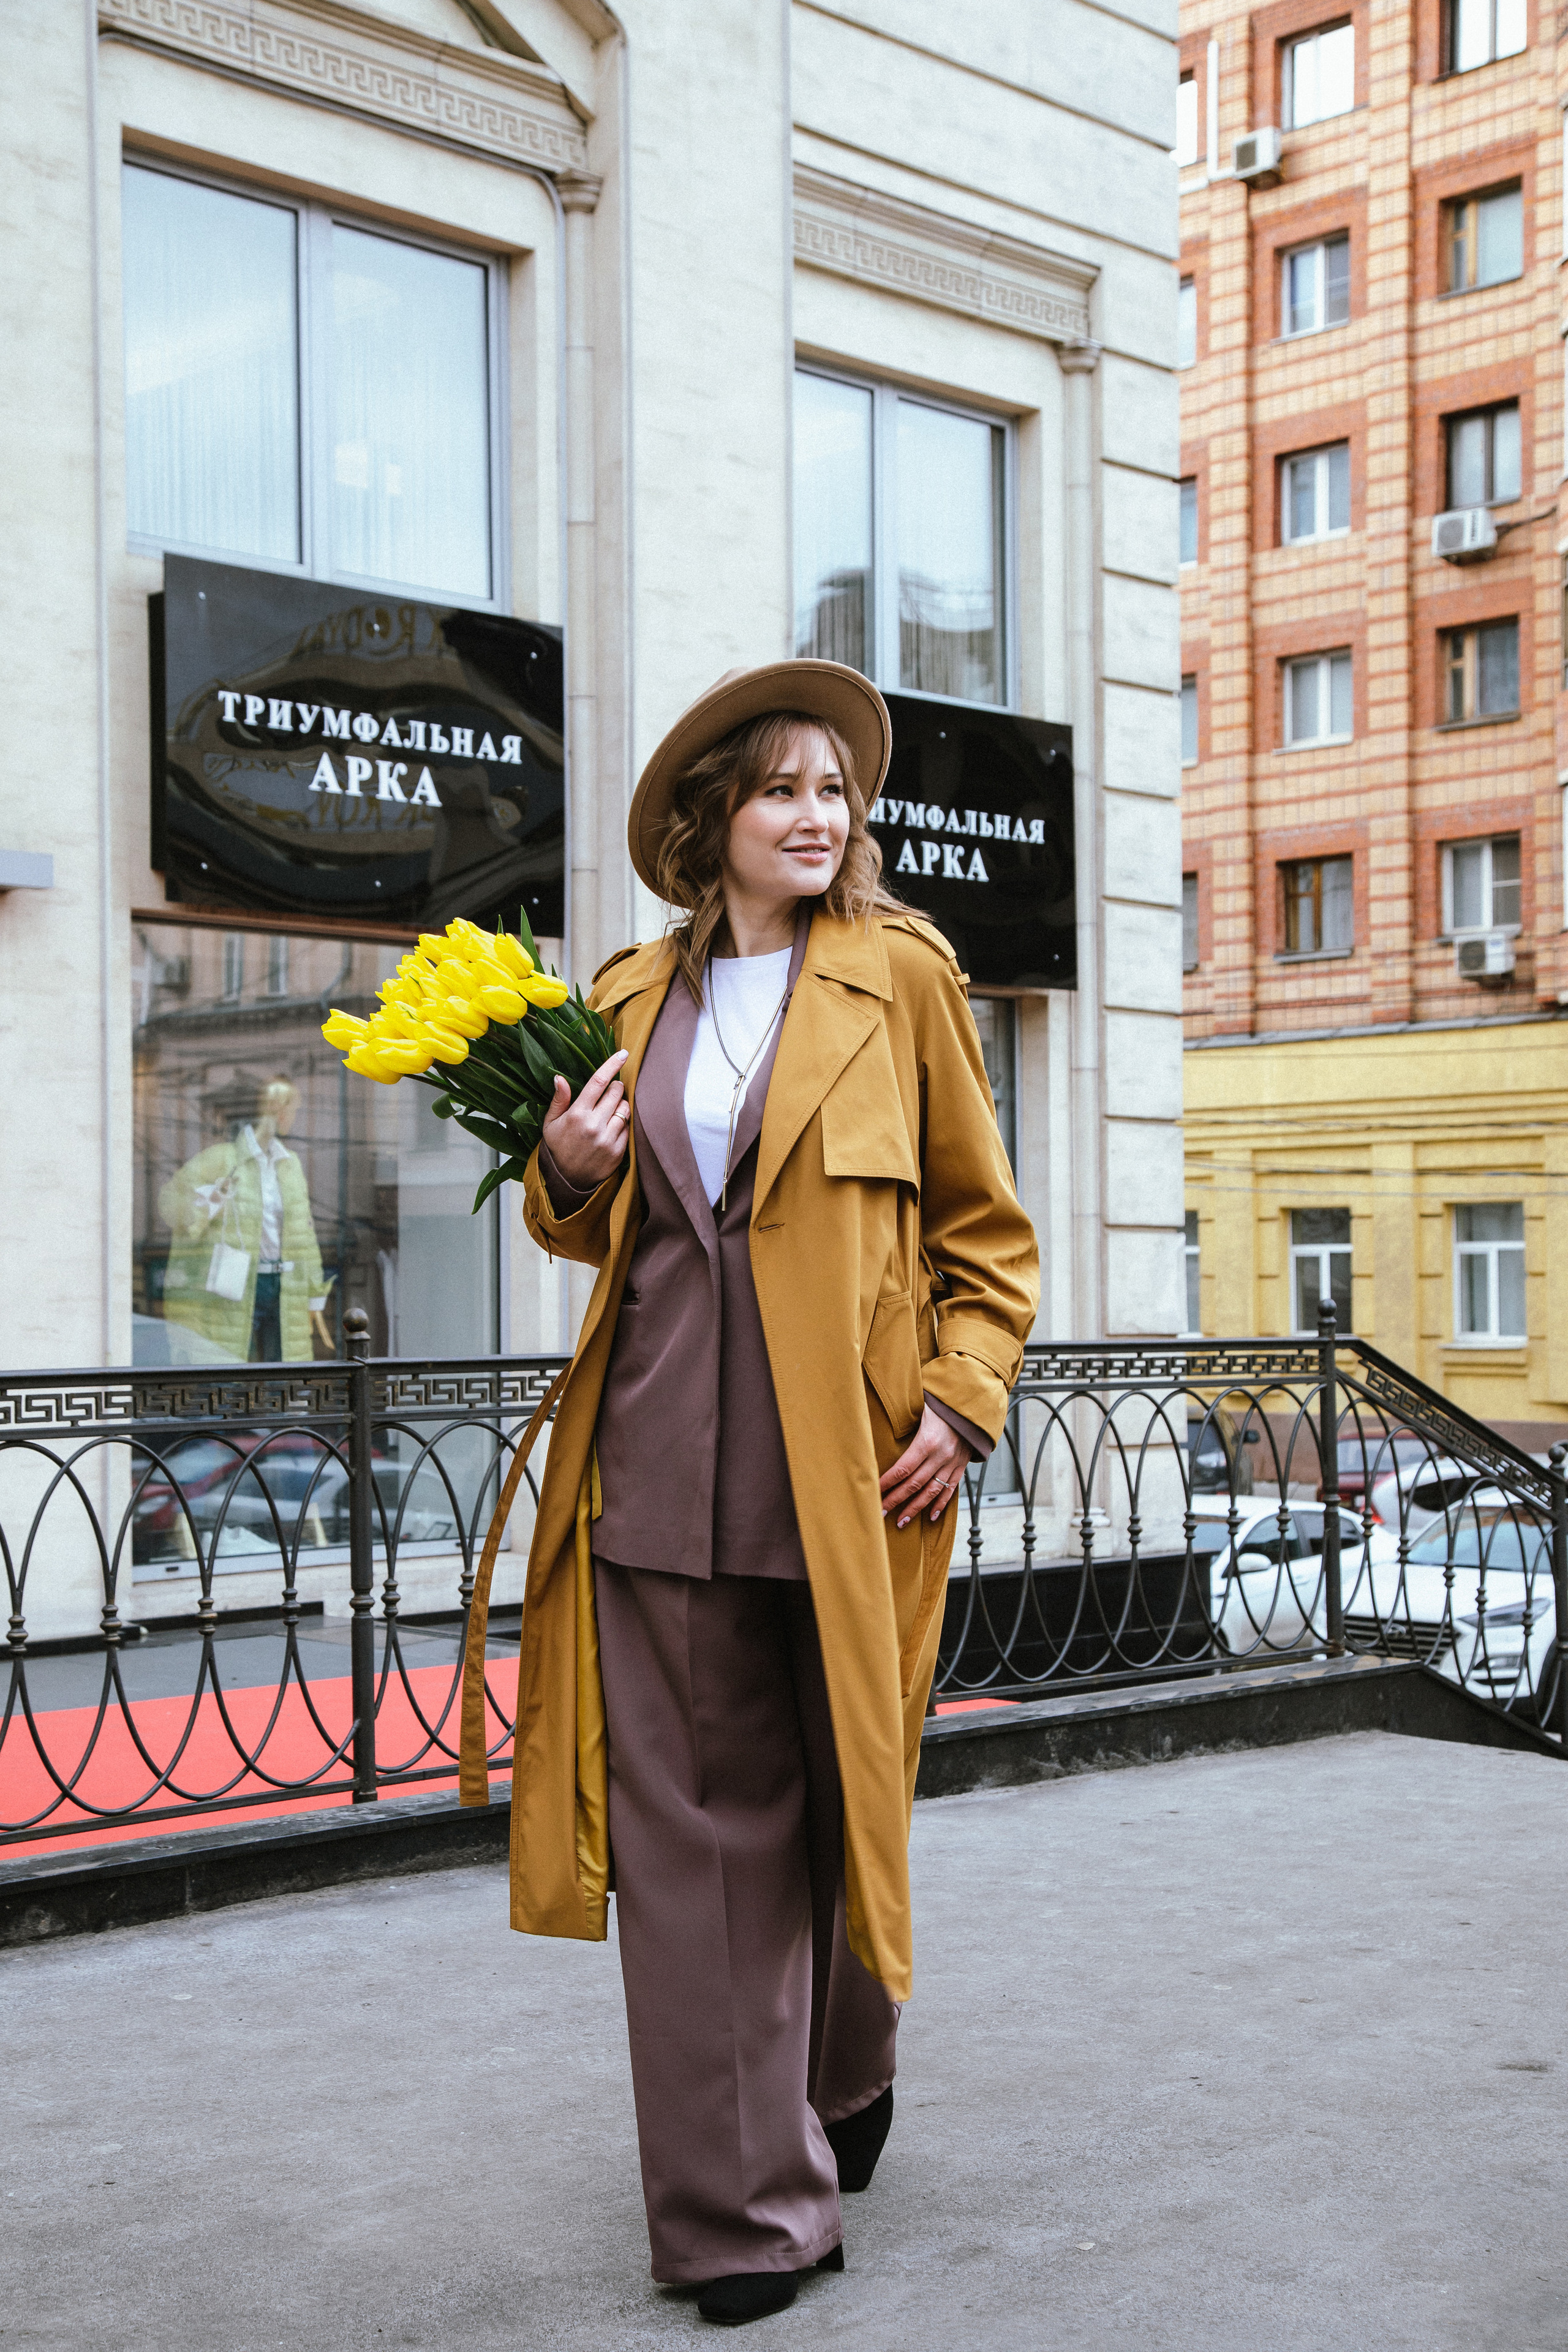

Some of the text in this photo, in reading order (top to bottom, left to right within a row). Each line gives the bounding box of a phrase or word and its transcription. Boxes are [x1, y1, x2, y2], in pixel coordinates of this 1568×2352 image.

[217, 690, 522, 764] ТРИУМФАЛЬНАЯ
[307, 752, 443, 807] АРКА
[868, 797, 1045, 844] ИУМФАЛЬНАЯ
[895, 839, 989, 882] АРКА
